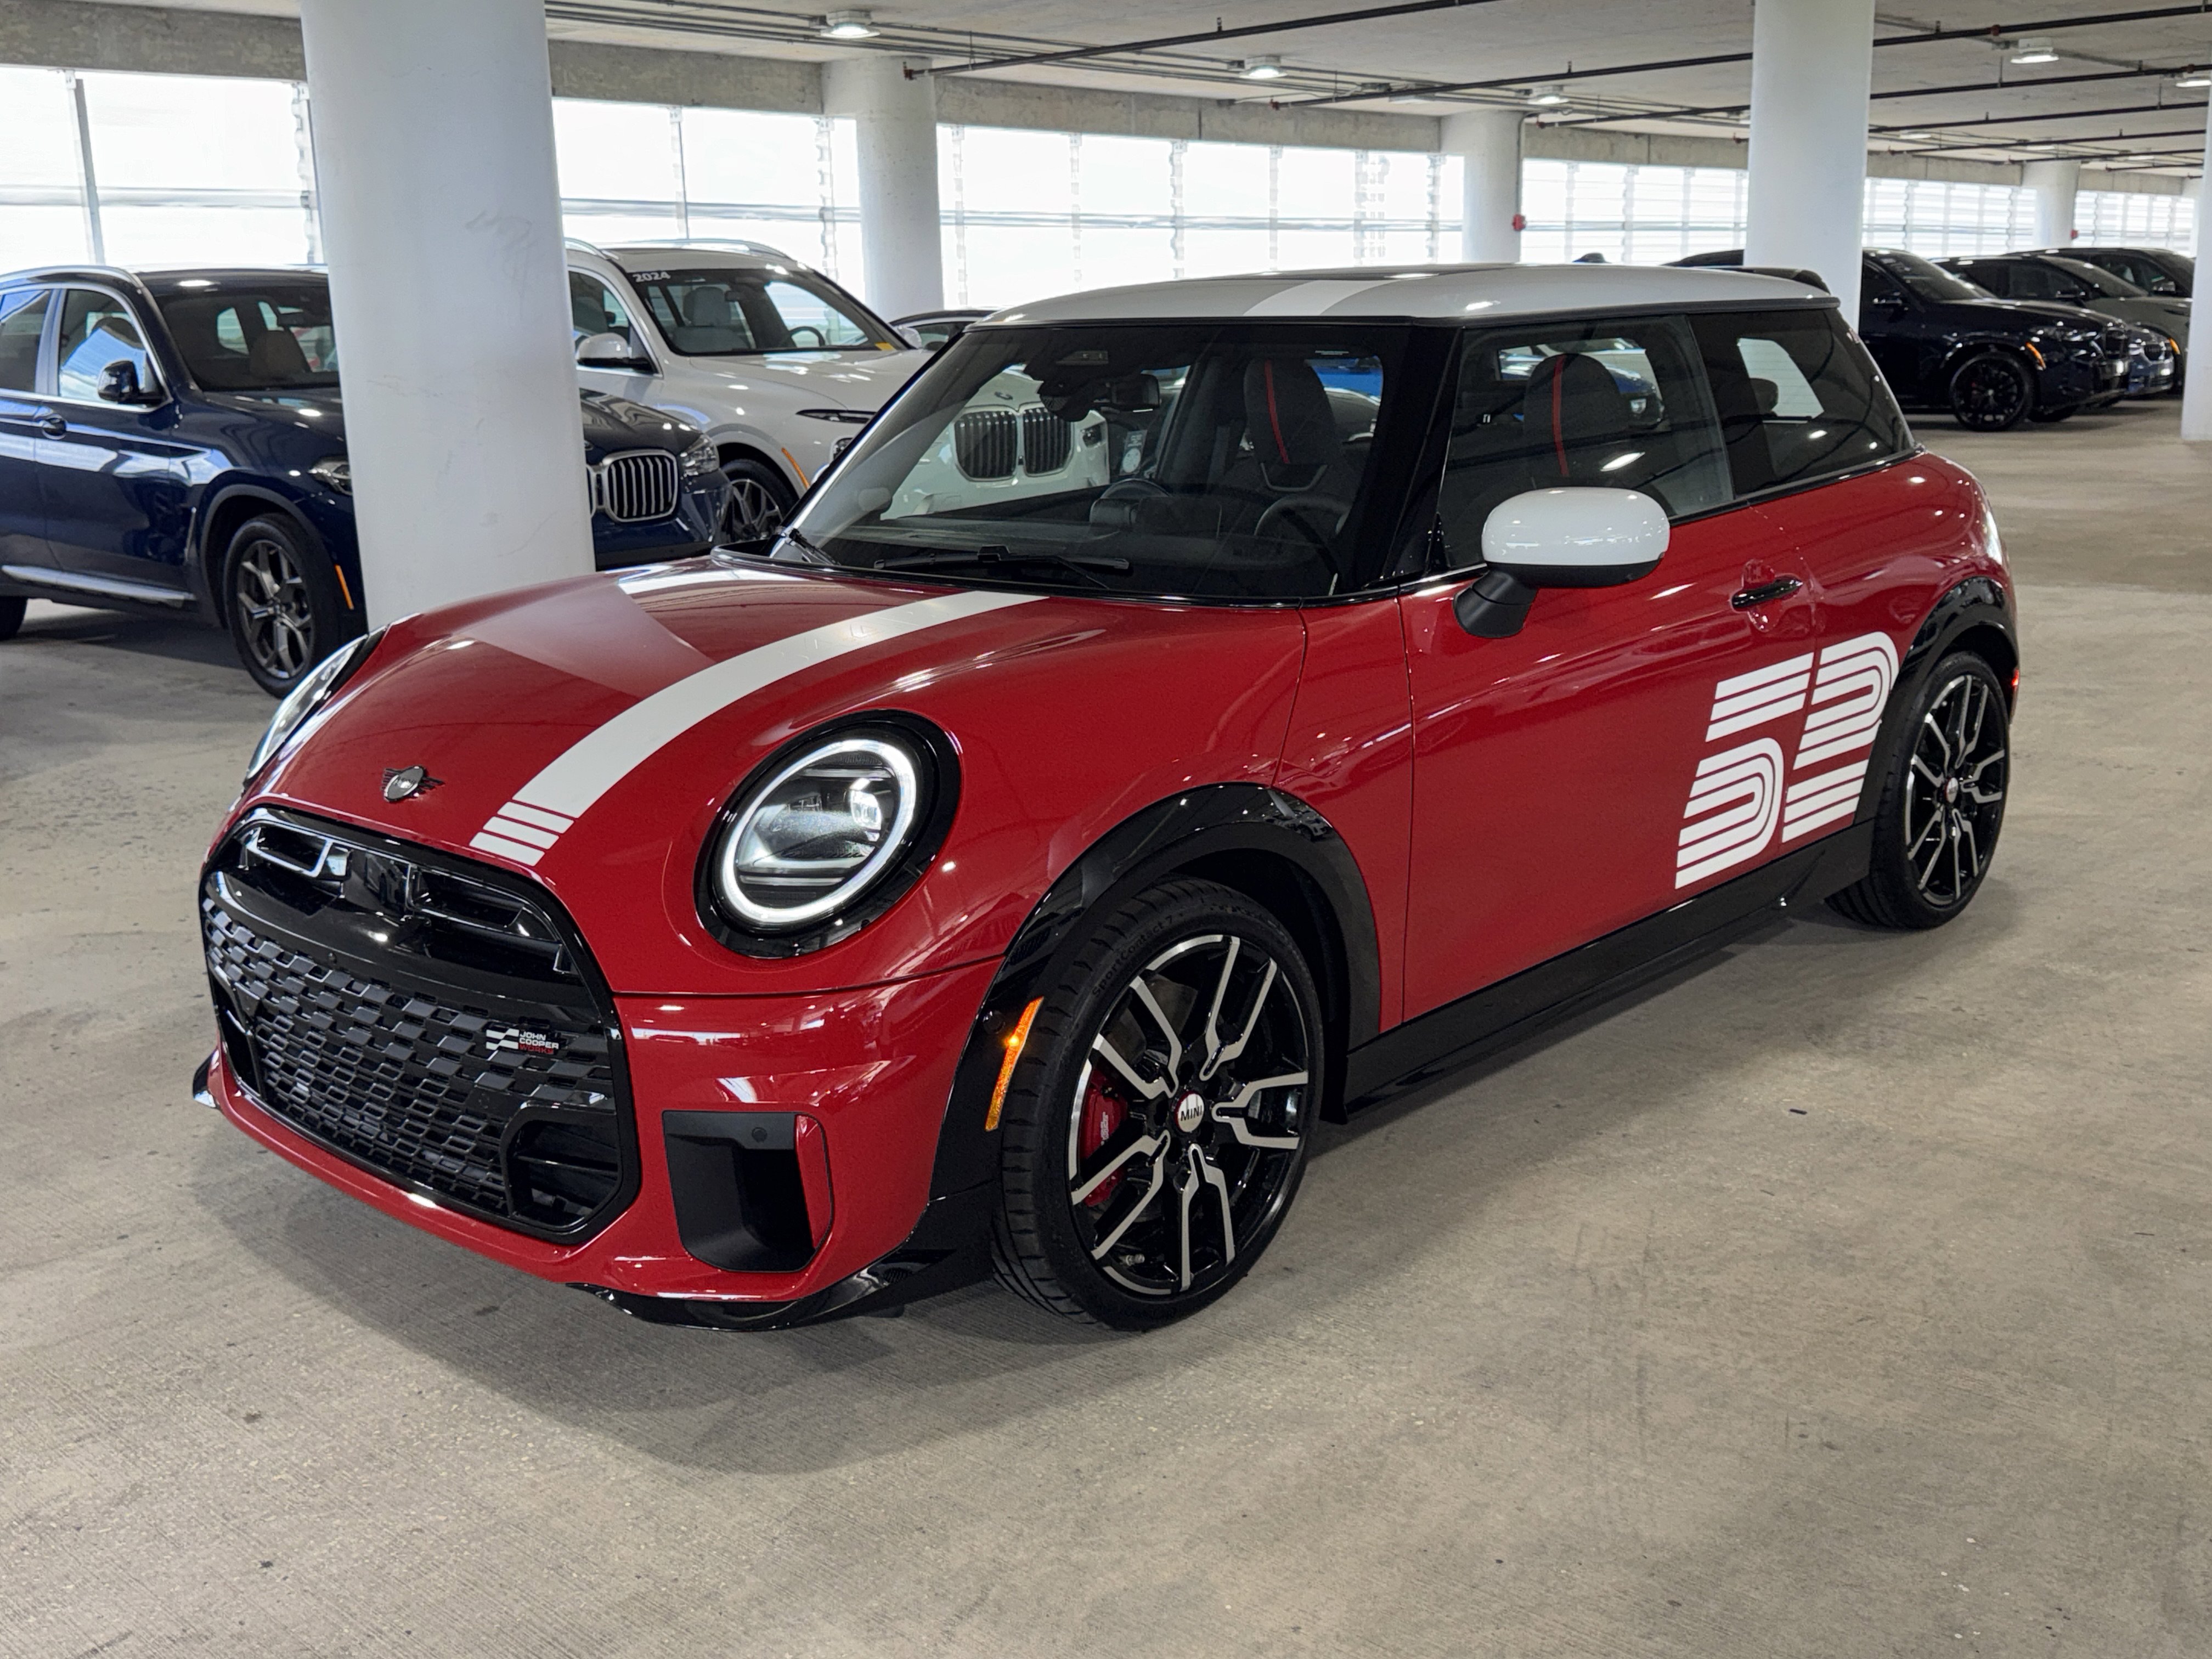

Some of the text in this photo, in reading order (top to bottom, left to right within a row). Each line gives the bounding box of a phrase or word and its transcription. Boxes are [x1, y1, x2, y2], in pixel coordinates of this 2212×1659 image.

[633, 271, 671, 283] 2024
[520, 1031, 546, 1041] JOHN
[519, 1037, 559, 1049] COOPER
[519, 1043, 554, 1054] WORKS
[1181, 1105, 1202, 1121] MINI
